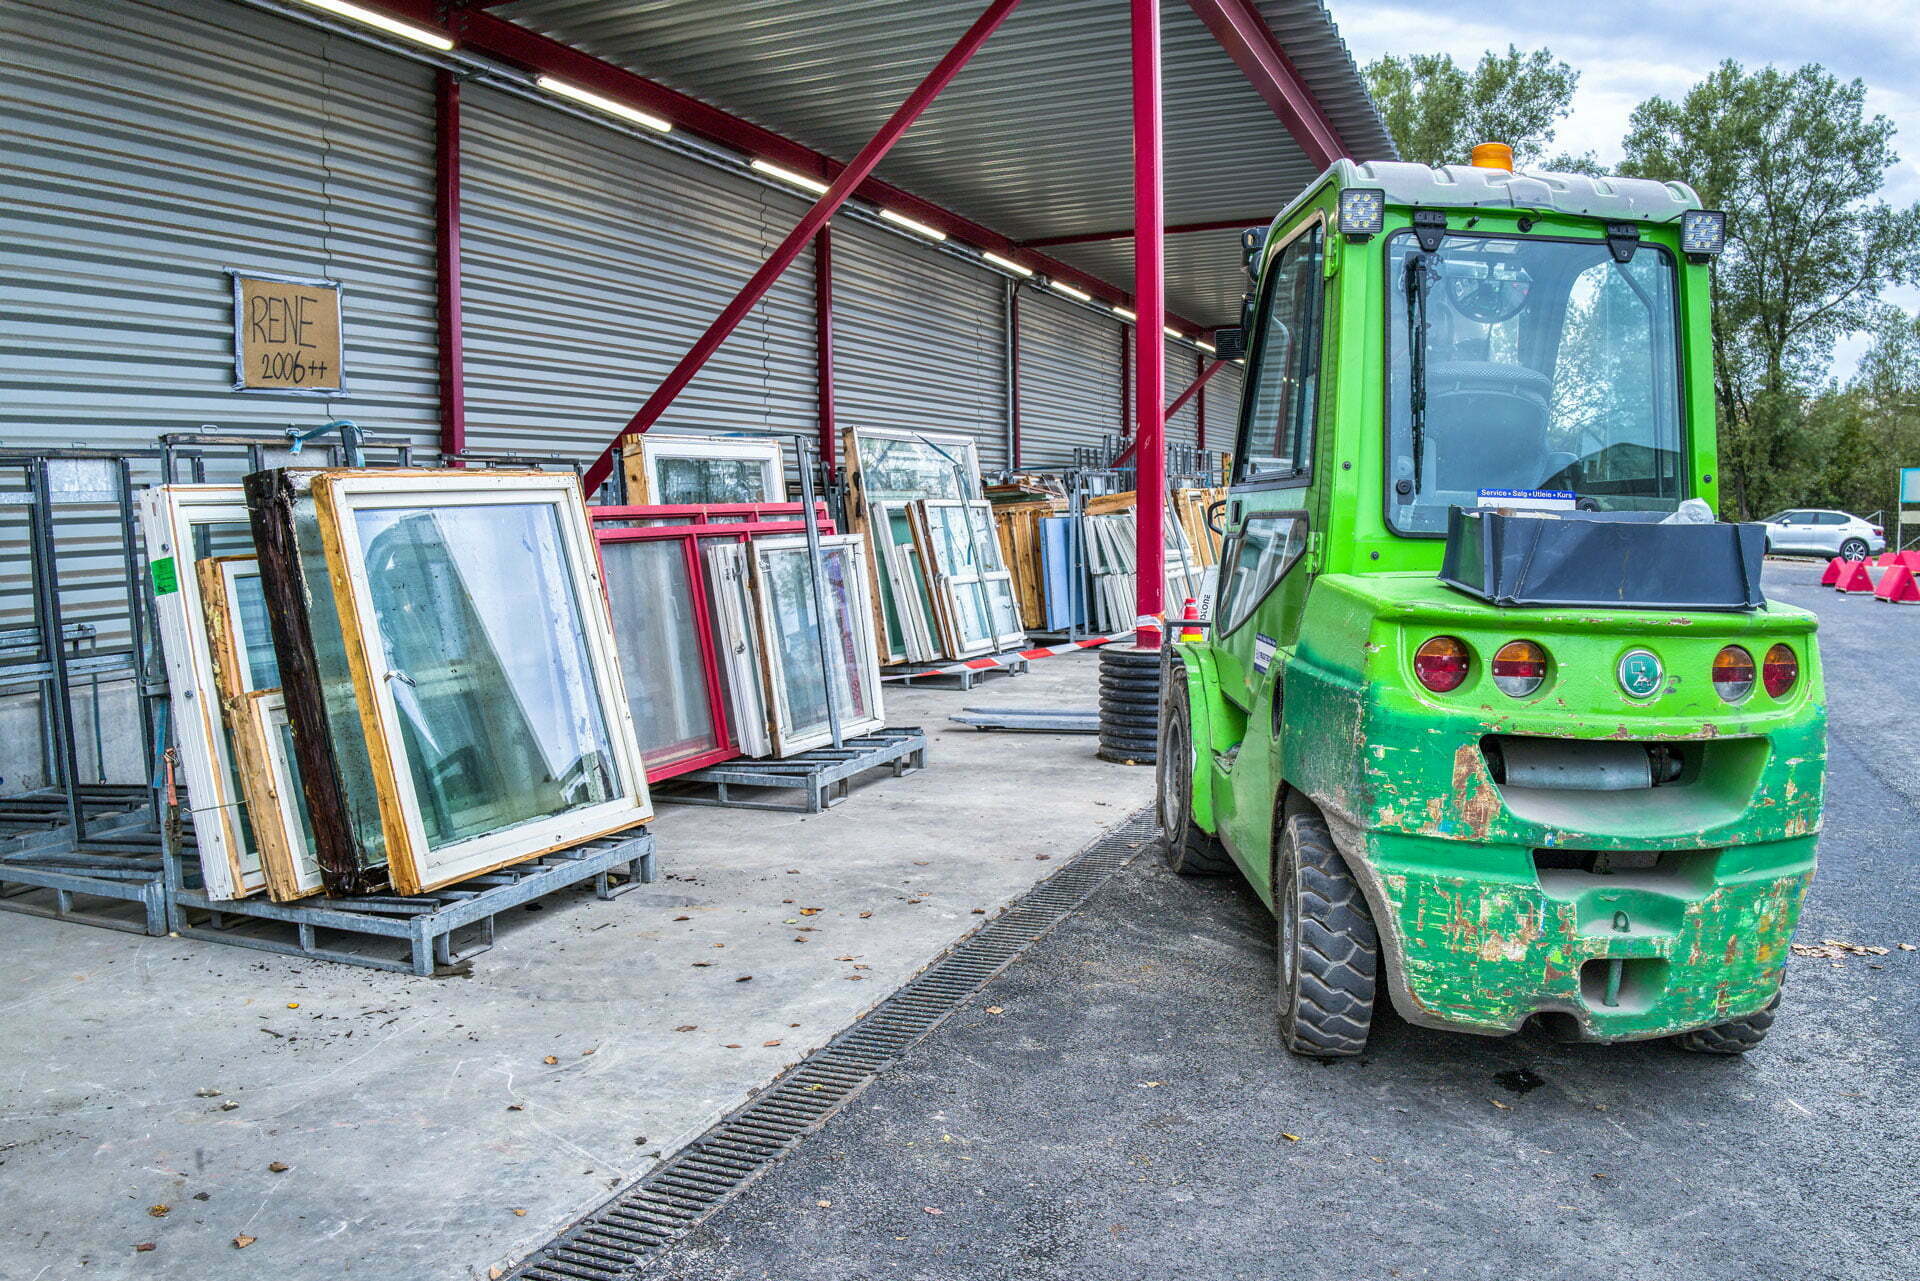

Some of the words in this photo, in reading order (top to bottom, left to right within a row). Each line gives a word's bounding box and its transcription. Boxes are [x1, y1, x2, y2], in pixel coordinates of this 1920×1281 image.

[251, 295, 318, 348] RENE
[261, 350, 328, 384] 2006++
[1481, 488, 1507, 497] Service
[1512, 489, 1528, 498] Salg
[1532, 490, 1552, 498] Utleie
[1556, 491, 1573, 499] Kurs
